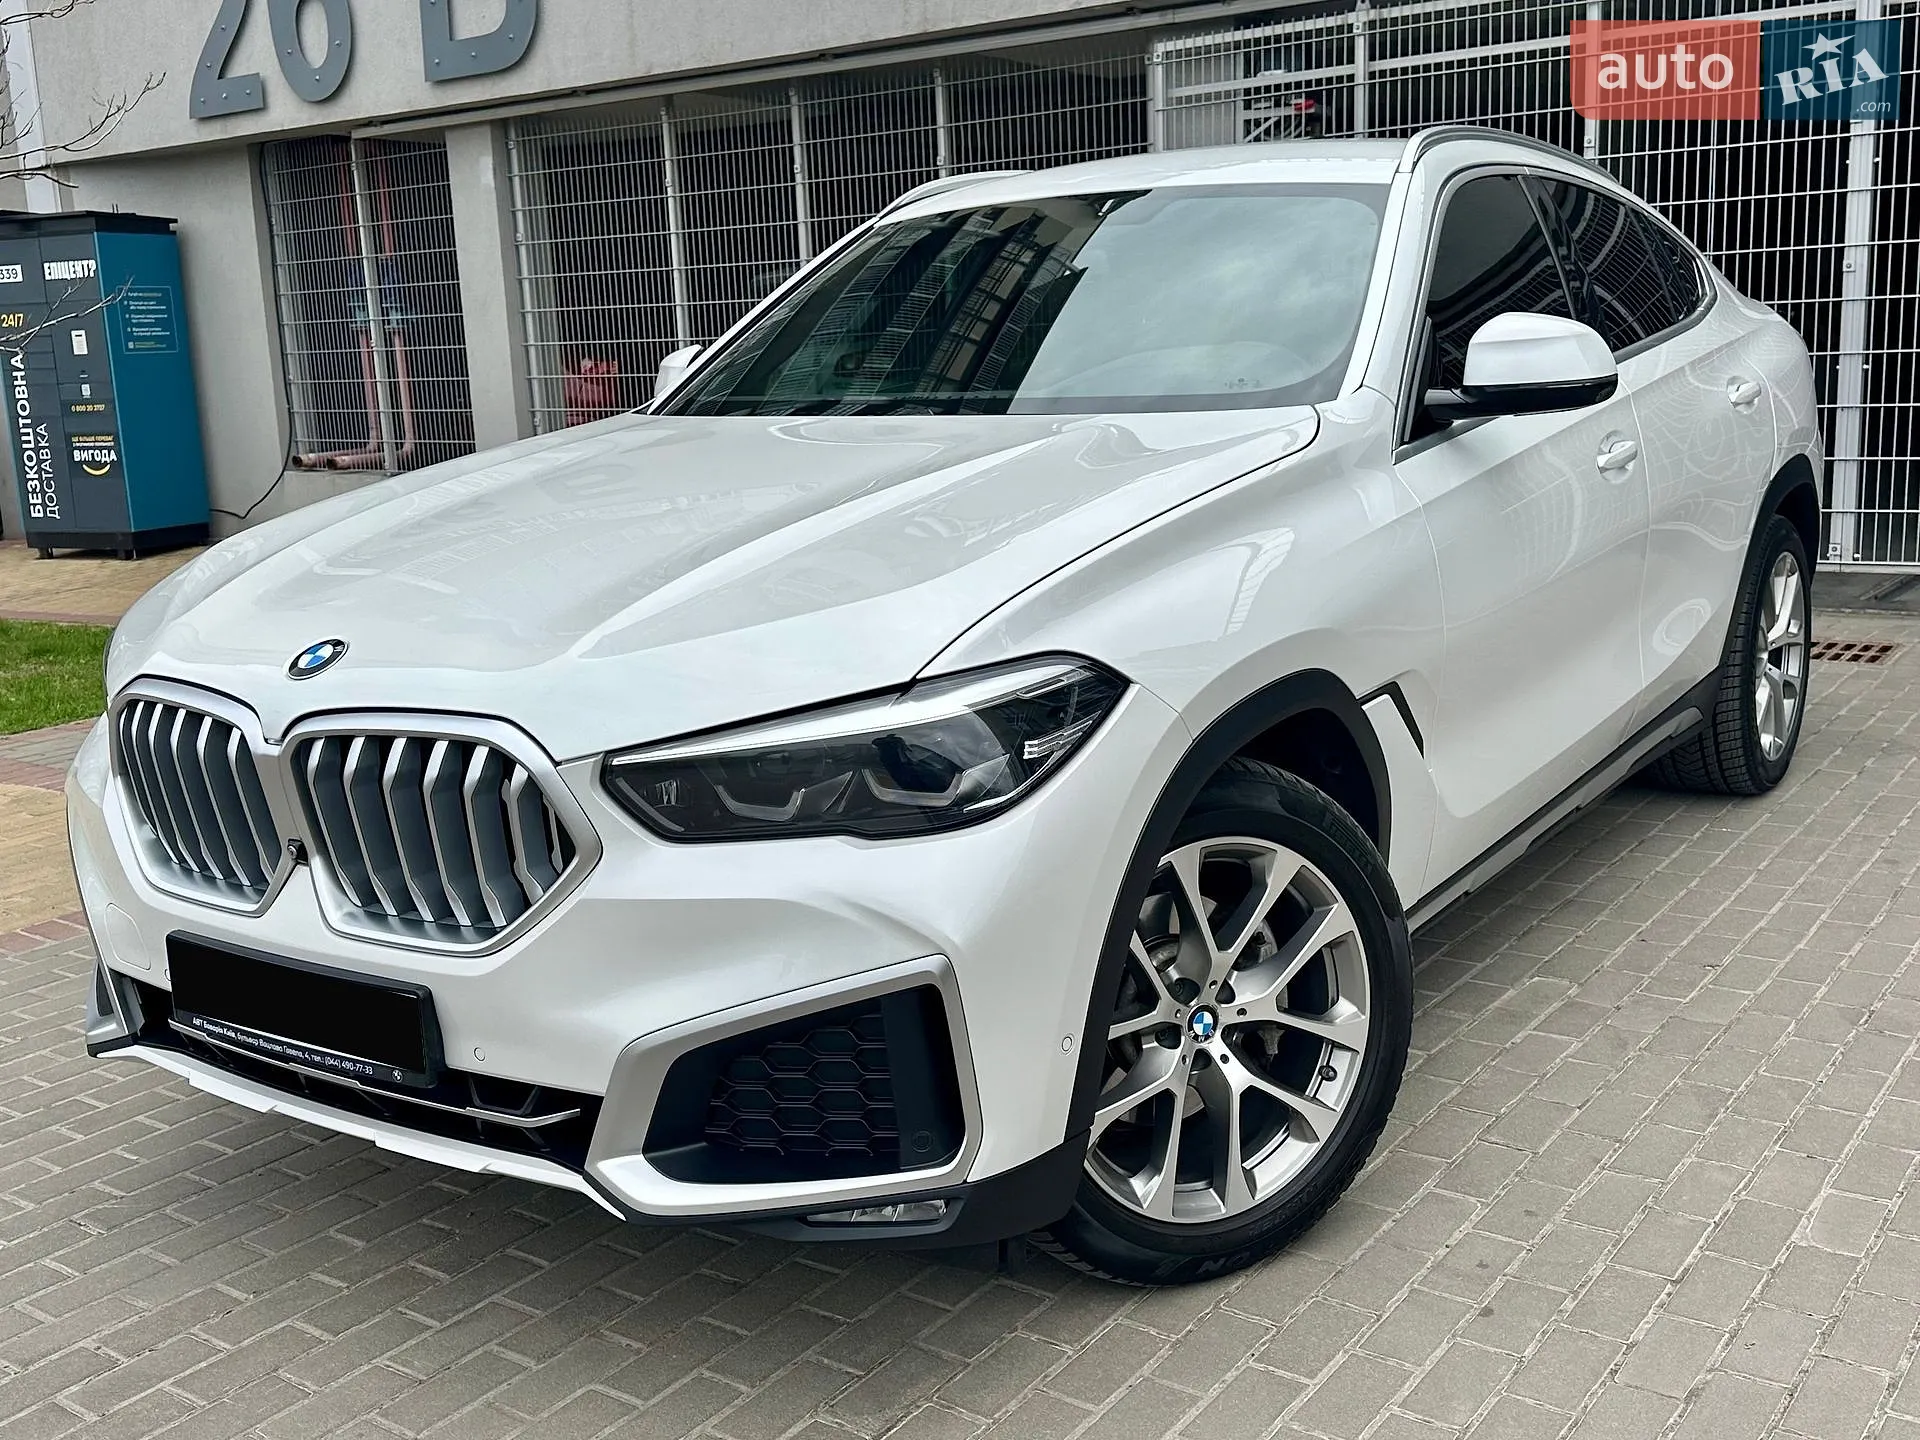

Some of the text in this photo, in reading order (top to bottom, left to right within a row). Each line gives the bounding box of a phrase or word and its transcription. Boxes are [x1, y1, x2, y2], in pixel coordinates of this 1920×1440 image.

[11, 352, 44, 518] БЕЗКОШТОВНА
[36, 423, 60, 519] ДОСТАВКА
[73, 449, 117, 463] ВИГОДА
